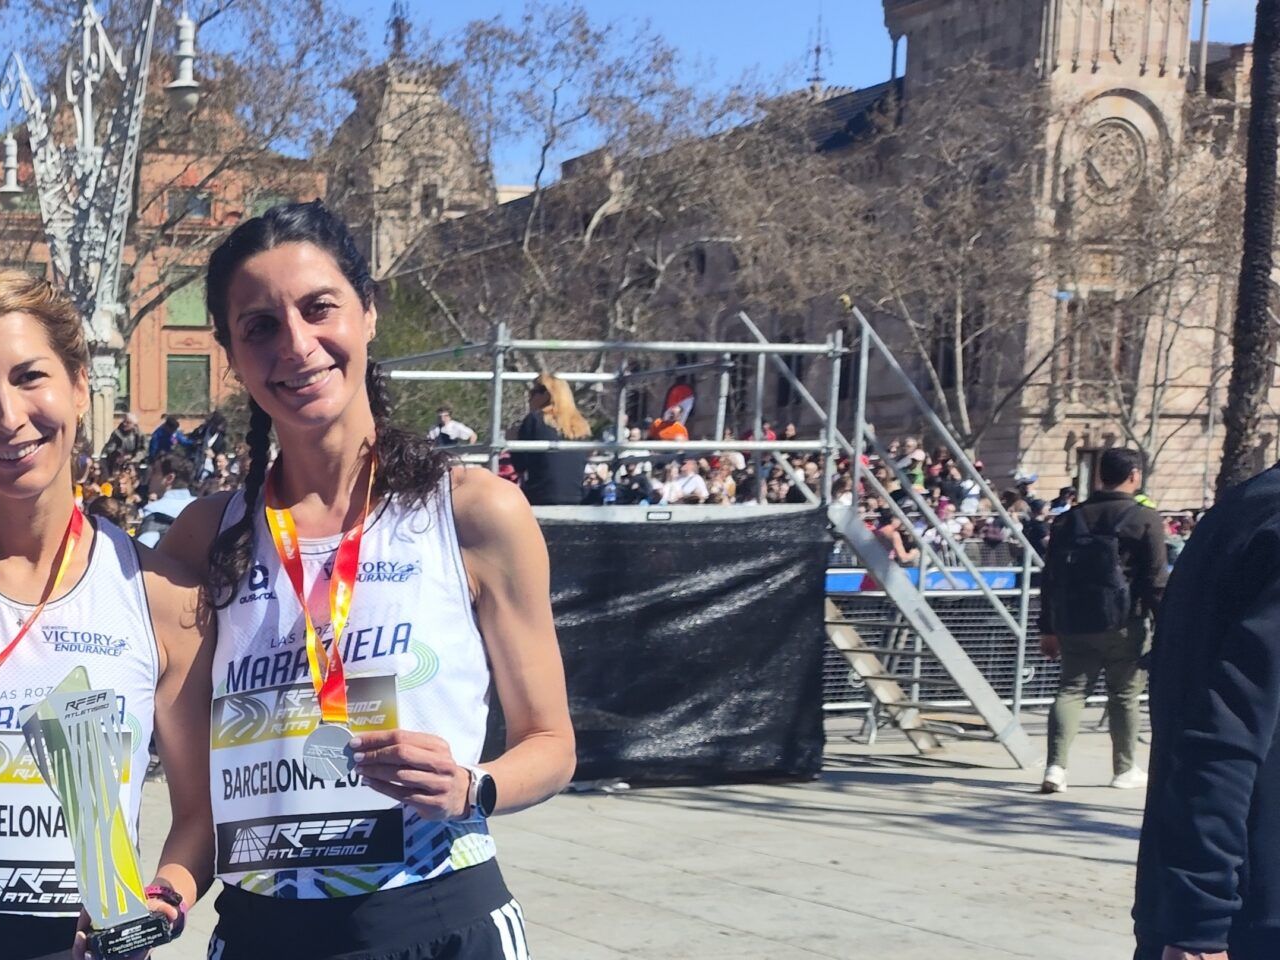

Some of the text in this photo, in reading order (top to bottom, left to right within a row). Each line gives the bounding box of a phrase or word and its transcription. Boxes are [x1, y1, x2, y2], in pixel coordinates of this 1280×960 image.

[42, 630, 112, 646] VICTORY
[270, 633, 296, 649] LAS
[54, 643, 121, 657] ENDURANCE
[24, 686, 54, 698] ROZ
[276, 700, 382, 719] ATLESMO
[270, 818, 379, 848] RFEA
[266, 844, 369, 861] ATLETISMO
[8, 867, 78, 894] RFE
[2, 891, 83, 904] ATLETIS
